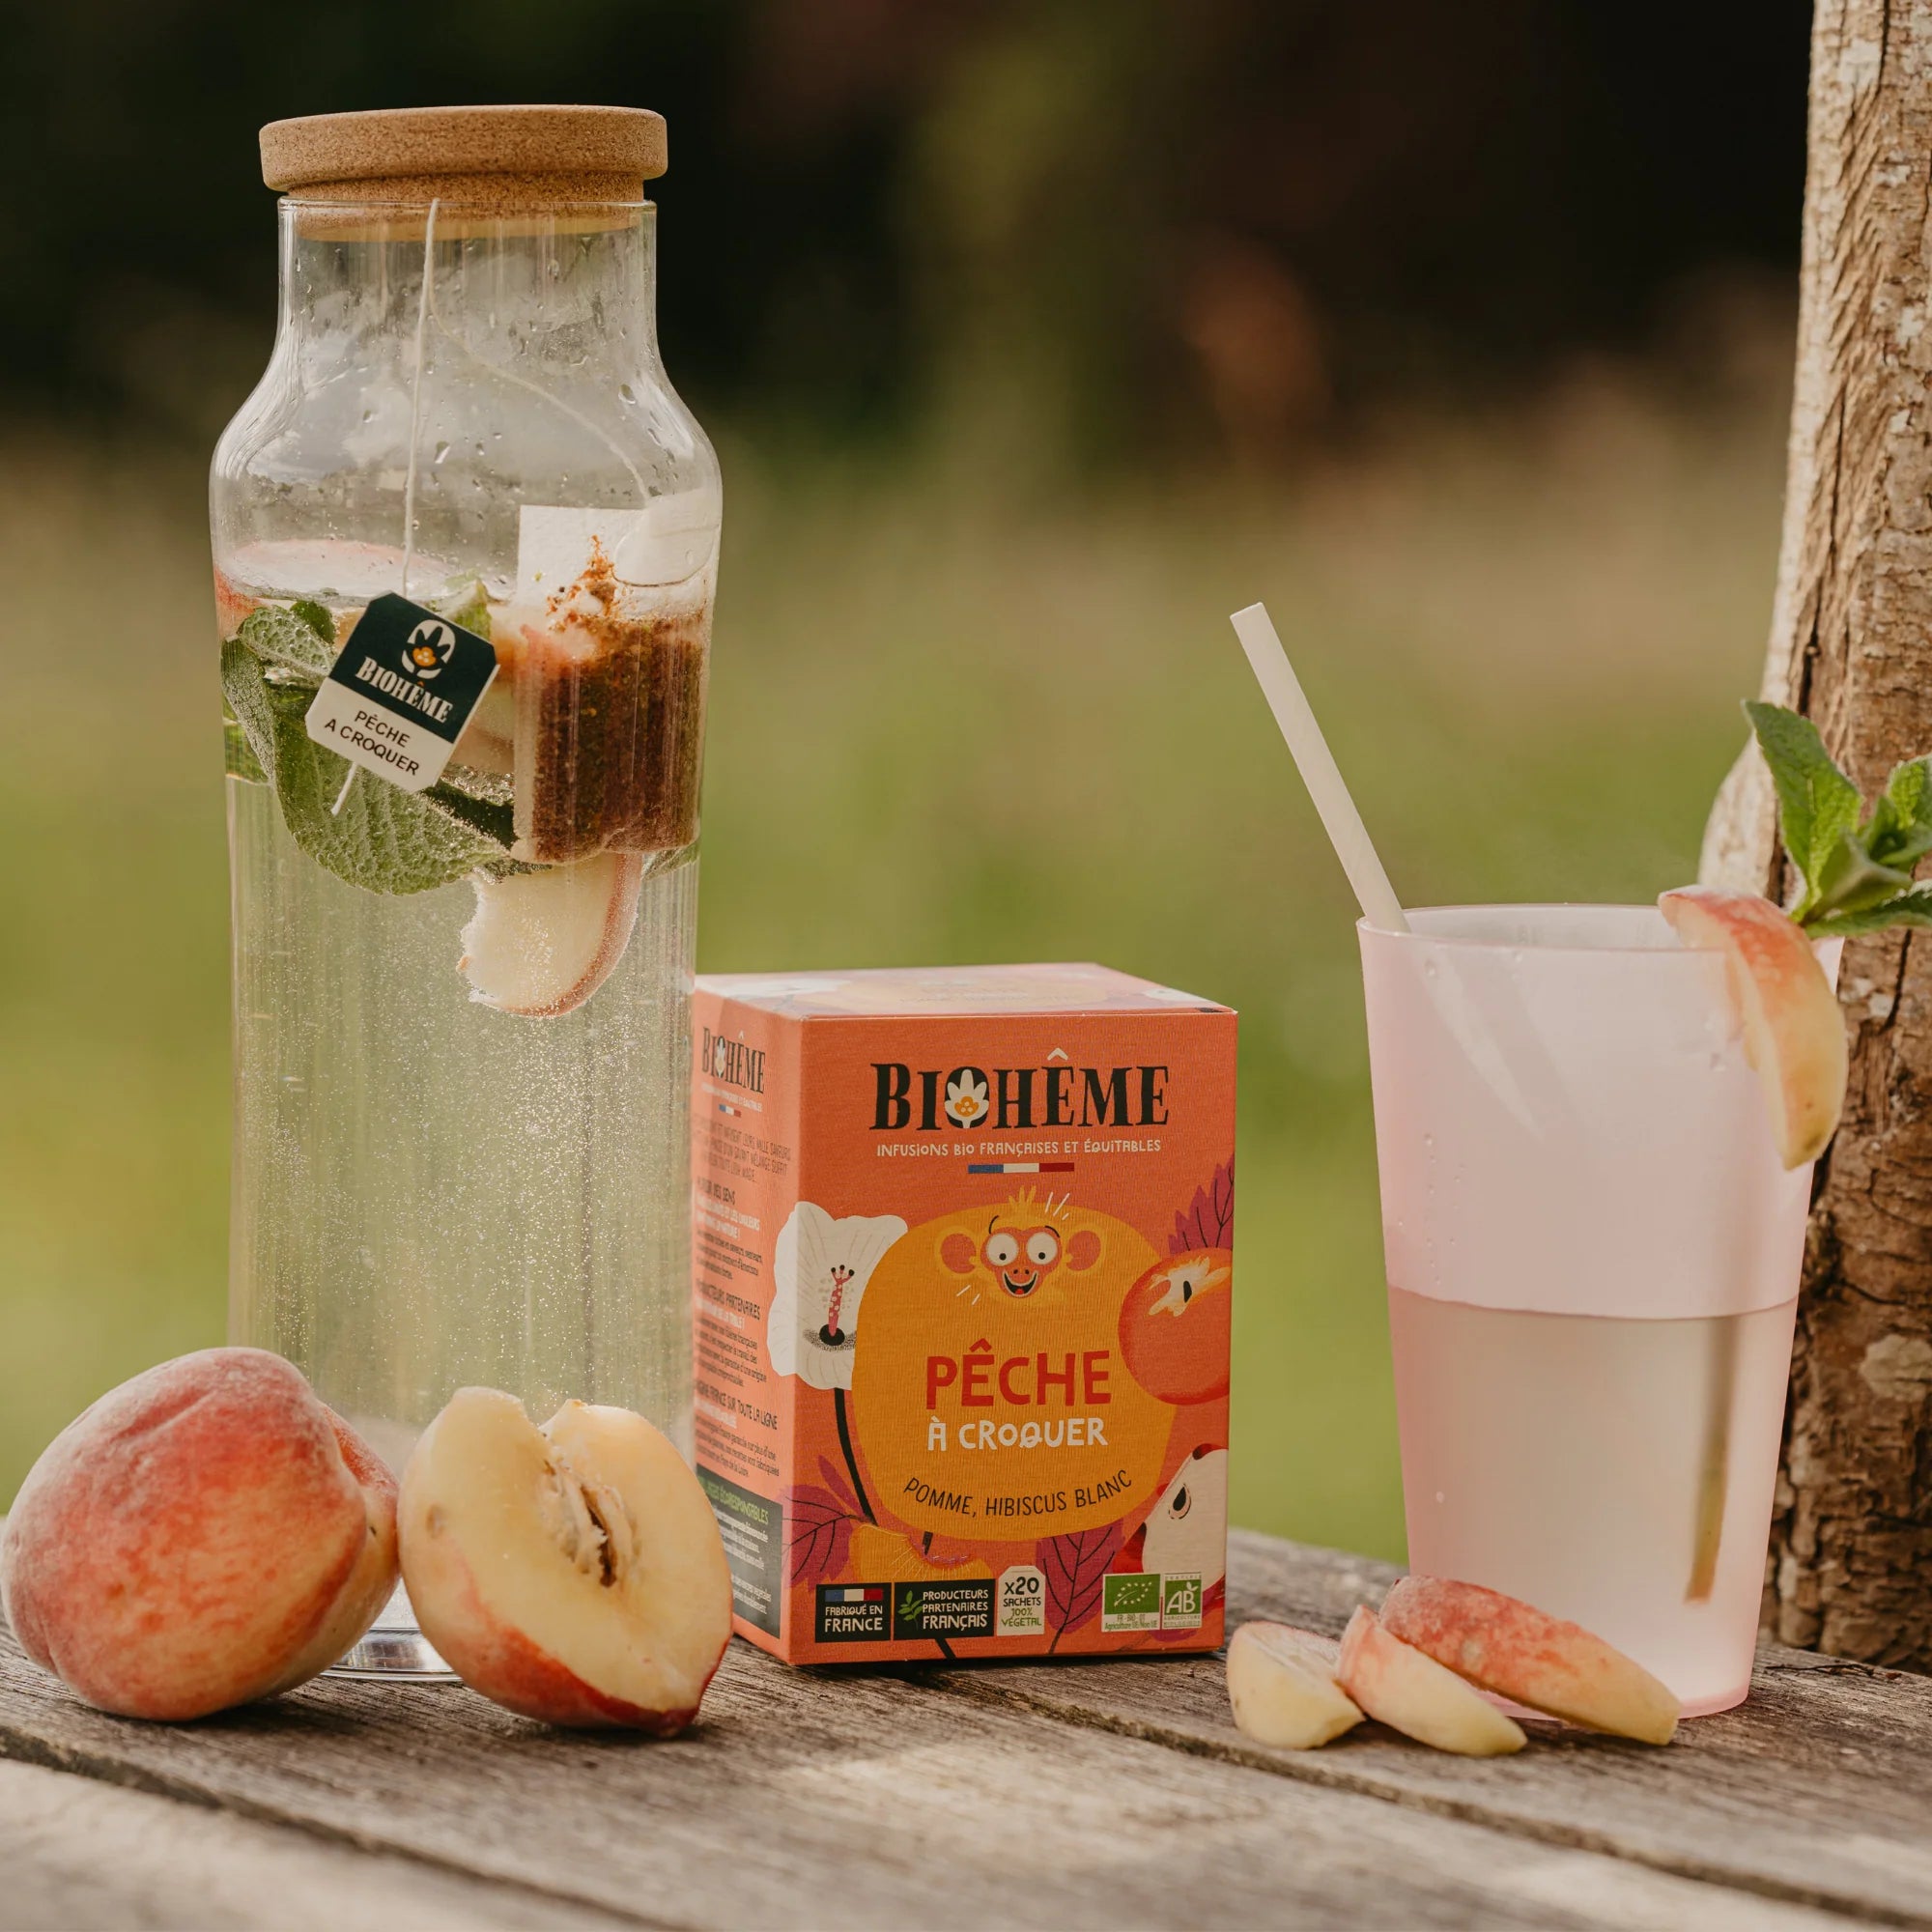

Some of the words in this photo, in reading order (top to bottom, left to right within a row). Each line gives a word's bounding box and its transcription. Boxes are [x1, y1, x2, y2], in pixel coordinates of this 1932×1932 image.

[355, 656, 453, 724] BIOHÊME
[355, 710, 412, 748] PÊCHE
[325, 719, 336, 732] A
[339, 725, 420, 776] CROQUER
[869, 1047, 1169, 1130] BIOHÊME
[980, 1141, 1059, 1157] FRANÇAISES
[1064, 1141, 1079, 1153] ET
[925, 1338, 1111, 1409] PÊCHE
[761, 1411, 778, 1431] LIGNE
[927, 1415, 947, 1451] À
[958, 1417, 1108, 1450] CROQUER
[903, 1477, 977, 1518] POMME,
[985, 1491, 1067, 1517] HIBISCUS
[1075, 1469, 1132, 1508] BLANC
[923, 1589, 988, 1601] PRODUCTEURS
[1003, 1597, 1041, 1607] SACHETS
[1166, 1590, 1196, 1614] AB
[825, 1605, 867, 1616] FABRIQUÉ
[869, 1605, 883, 1615] EN
[923, 1602, 988, 1613] PARTENAIRES
[824, 1617, 883, 1633] FRANCE
[923, 1614, 987, 1631] FRANÇAIS
